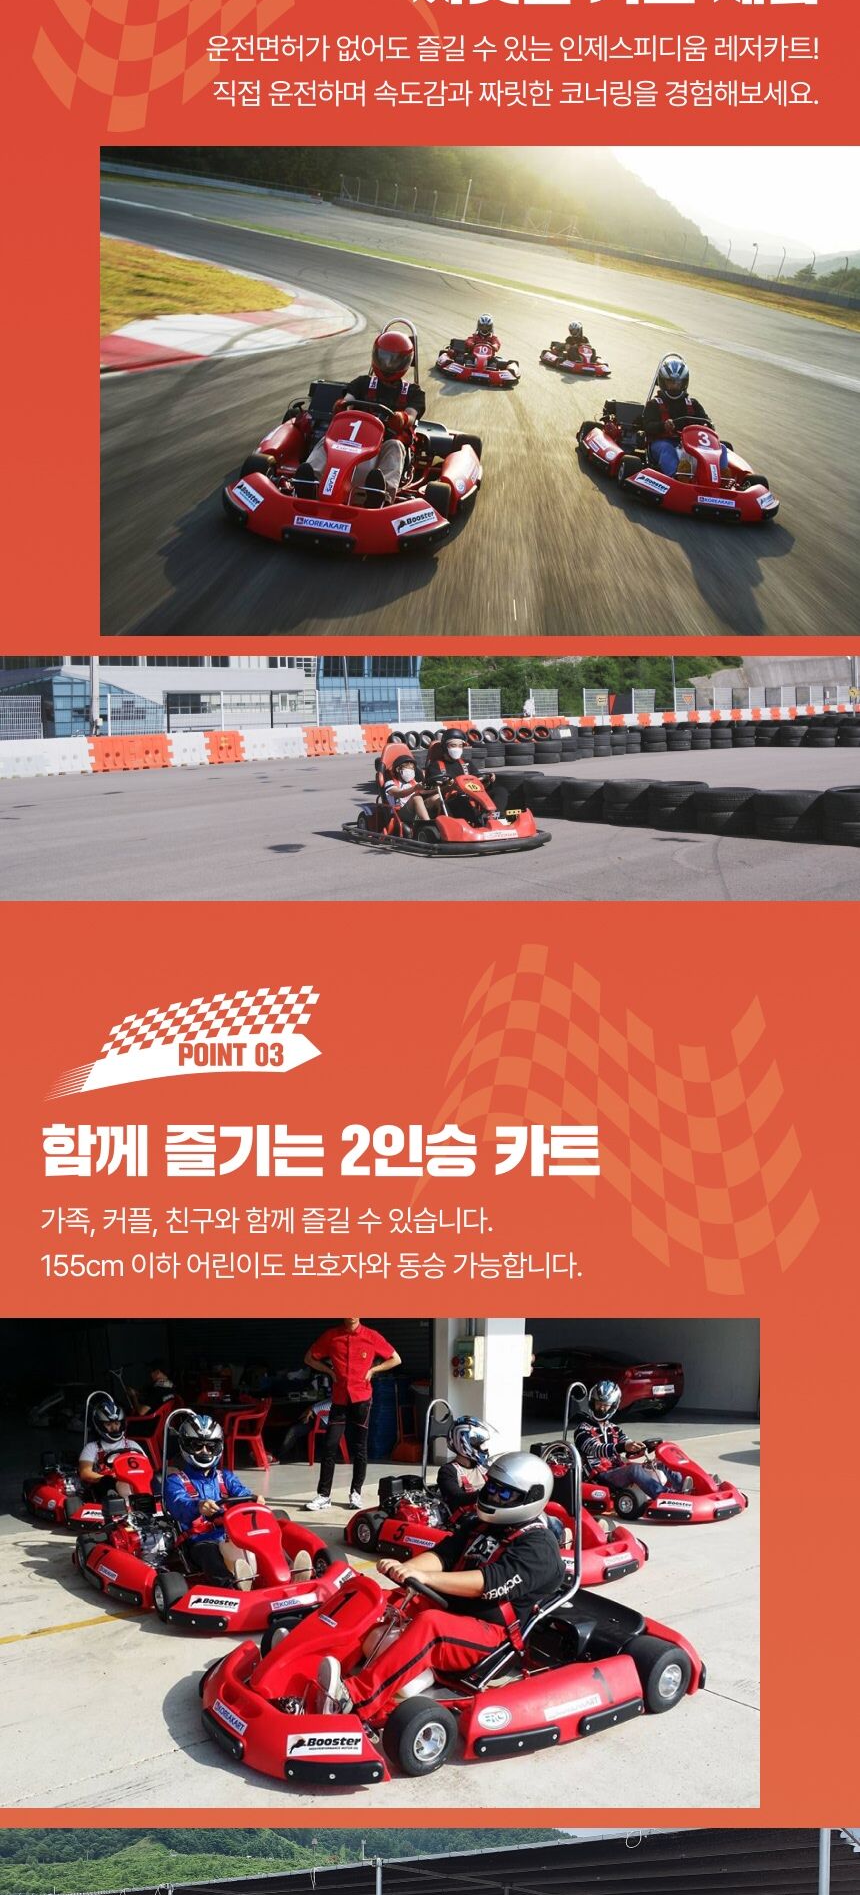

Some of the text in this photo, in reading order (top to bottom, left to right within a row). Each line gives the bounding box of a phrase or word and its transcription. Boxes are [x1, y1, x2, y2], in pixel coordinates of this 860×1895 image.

[349, 420, 362, 442] 1
[697, 431, 711, 446] 3
[303, 518, 350, 532] KOREAKART
[406, 511, 434, 525] Booster
[127, 1457, 139, 1469] 6
[243, 1510, 257, 1530] 7
[202, 1598, 239, 1609] Booster
[217, 1704, 246, 1733] KOREAKART
[307, 1737, 361, 1746] Booster
